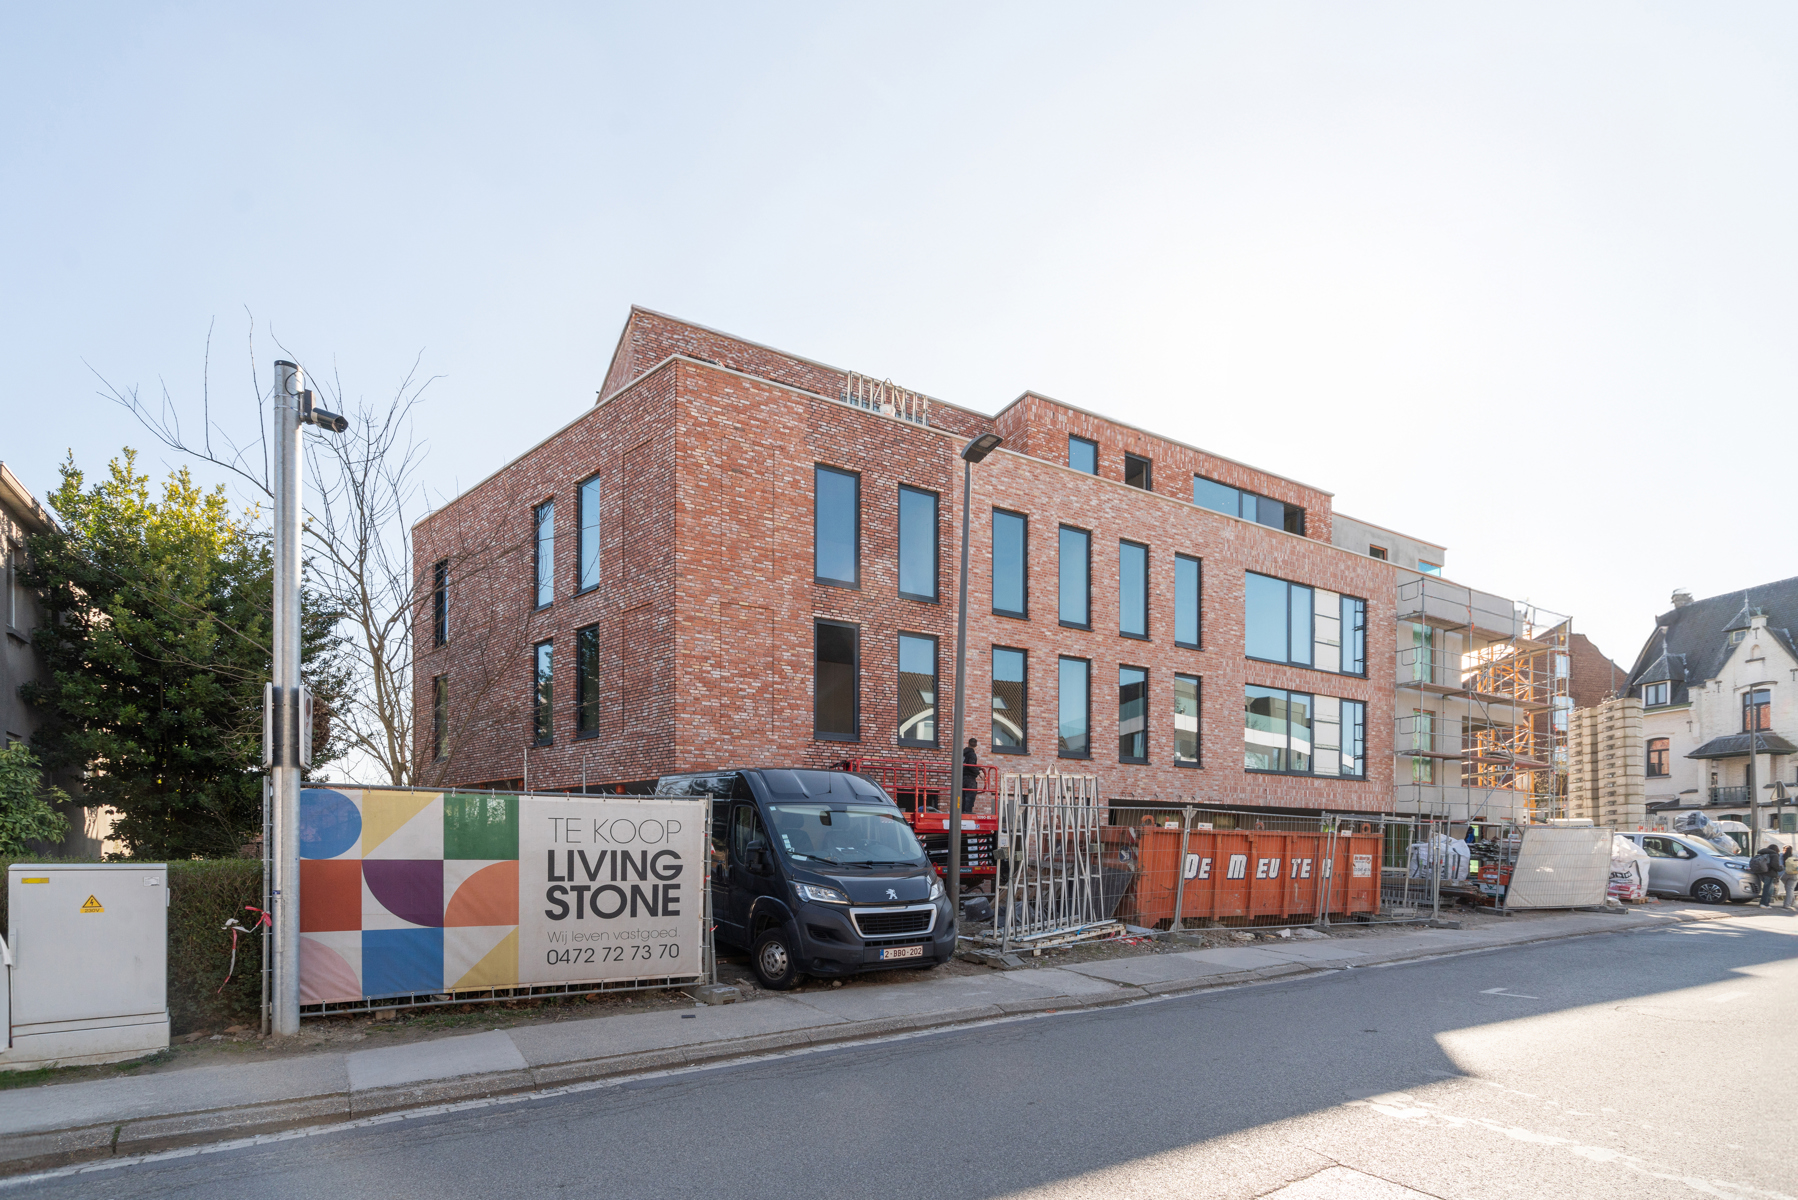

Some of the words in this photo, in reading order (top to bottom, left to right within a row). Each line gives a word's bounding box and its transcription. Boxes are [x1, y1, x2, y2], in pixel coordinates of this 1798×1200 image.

[547, 817, 582, 844] TE
[593, 818, 682, 845] KOOP
[547, 849, 684, 882] LIVING
[544, 883, 682, 921] STONE
[547, 930, 568, 946] Wij
[571, 930, 610, 943] leven
[612, 926, 681, 942] vastgoed.
[546, 947, 596, 966] 0472
[602, 945, 624, 963] 72
[630, 944, 652, 961] 73
[658, 943, 680, 959] 70
